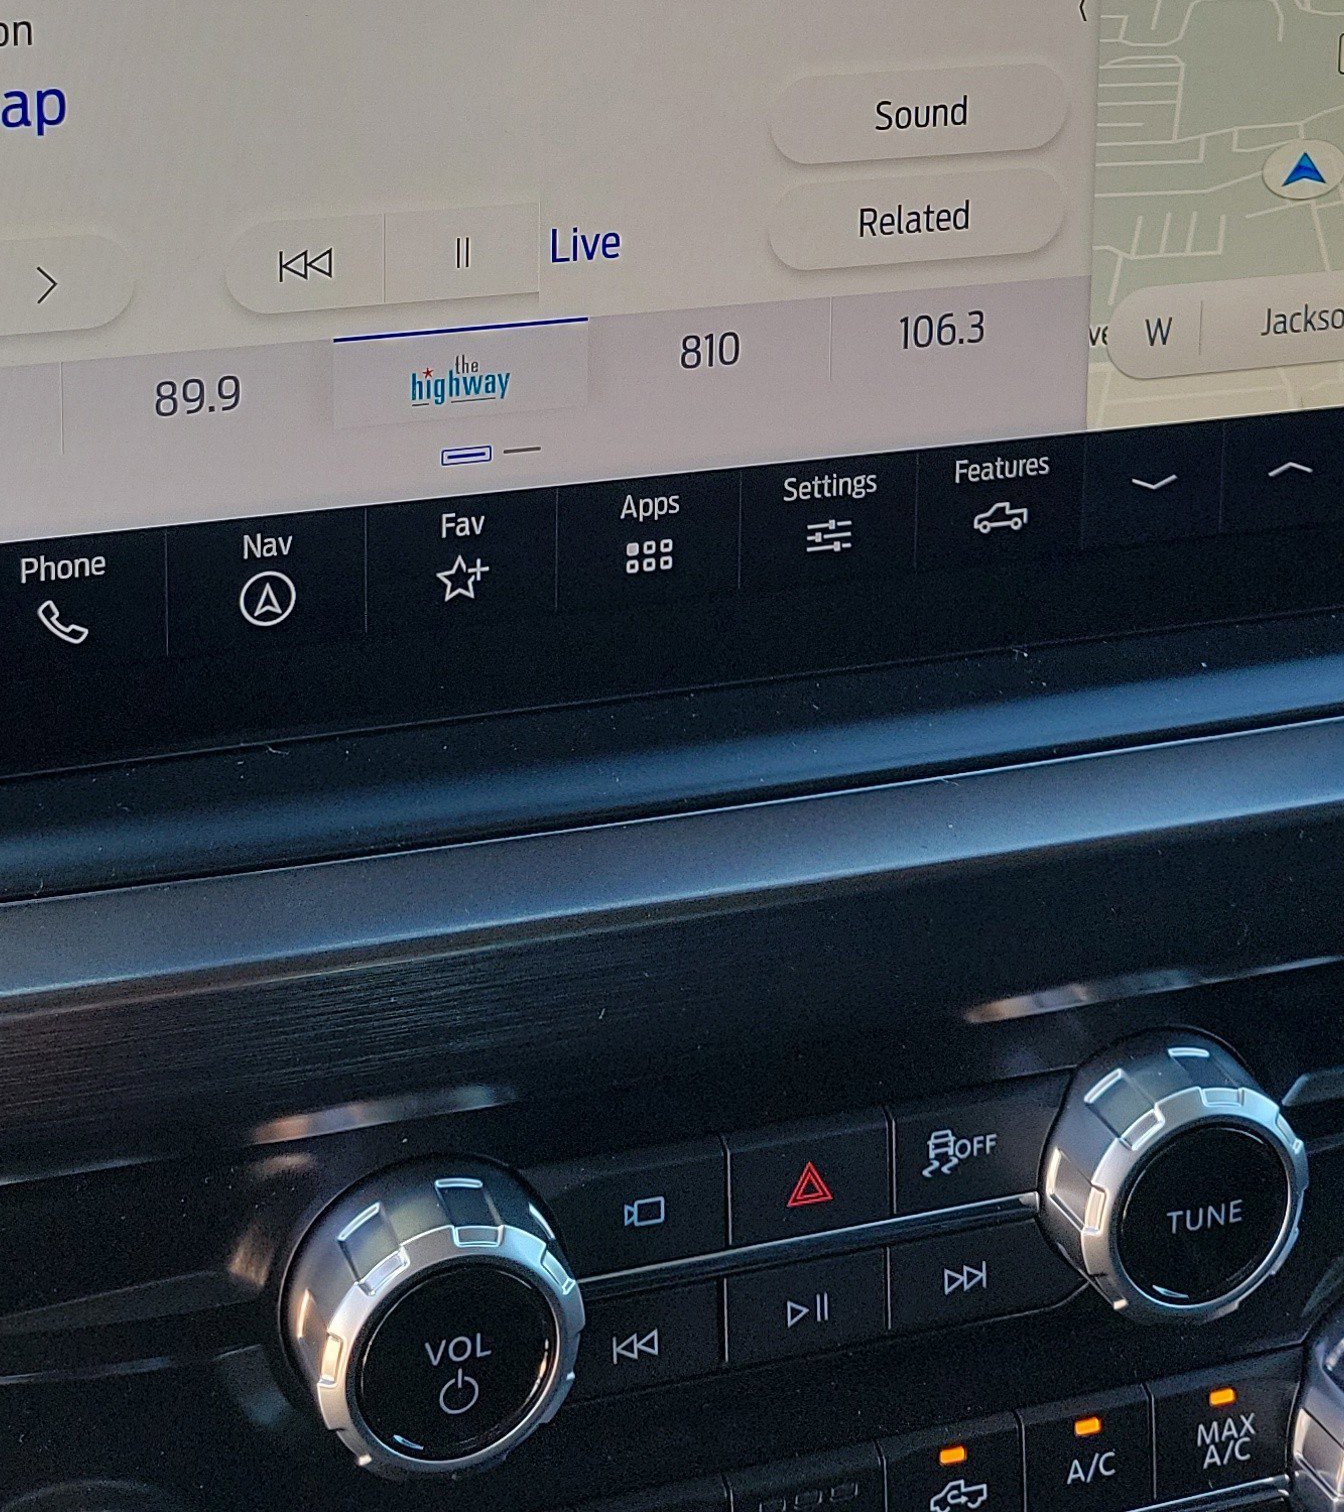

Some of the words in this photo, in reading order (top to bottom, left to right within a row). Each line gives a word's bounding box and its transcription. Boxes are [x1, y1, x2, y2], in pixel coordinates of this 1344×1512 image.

[874, 95, 969, 131] Sound
[859, 199, 971, 238] Related
[550, 226, 621, 264] Live
[898, 310, 986, 351] 106.3
[1145, 316, 1172, 346] W
[456, 355, 479, 375] the
[679, 332, 741, 370] 810
[156, 375, 241, 418] 89.9
[411, 369, 511, 405] highway
[955, 452, 1050, 484] Features
[783, 469, 878, 504] Settings
[441, 511, 486, 539] Fav
[620, 493, 681, 524] Apps
[243, 531, 293, 561] Nav
[20, 552, 107, 584] Phone
[955, 1132, 998, 1159] OFF
[1167, 1198, 1244, 1234] TUNE
[424, 1332, 492, 1366] VOL
[1196, 1412, 1256, 1445] MAX
[1066, 1449, 1117, 1486] A/C
[1202, 1436, 1252, 1471] A/C
